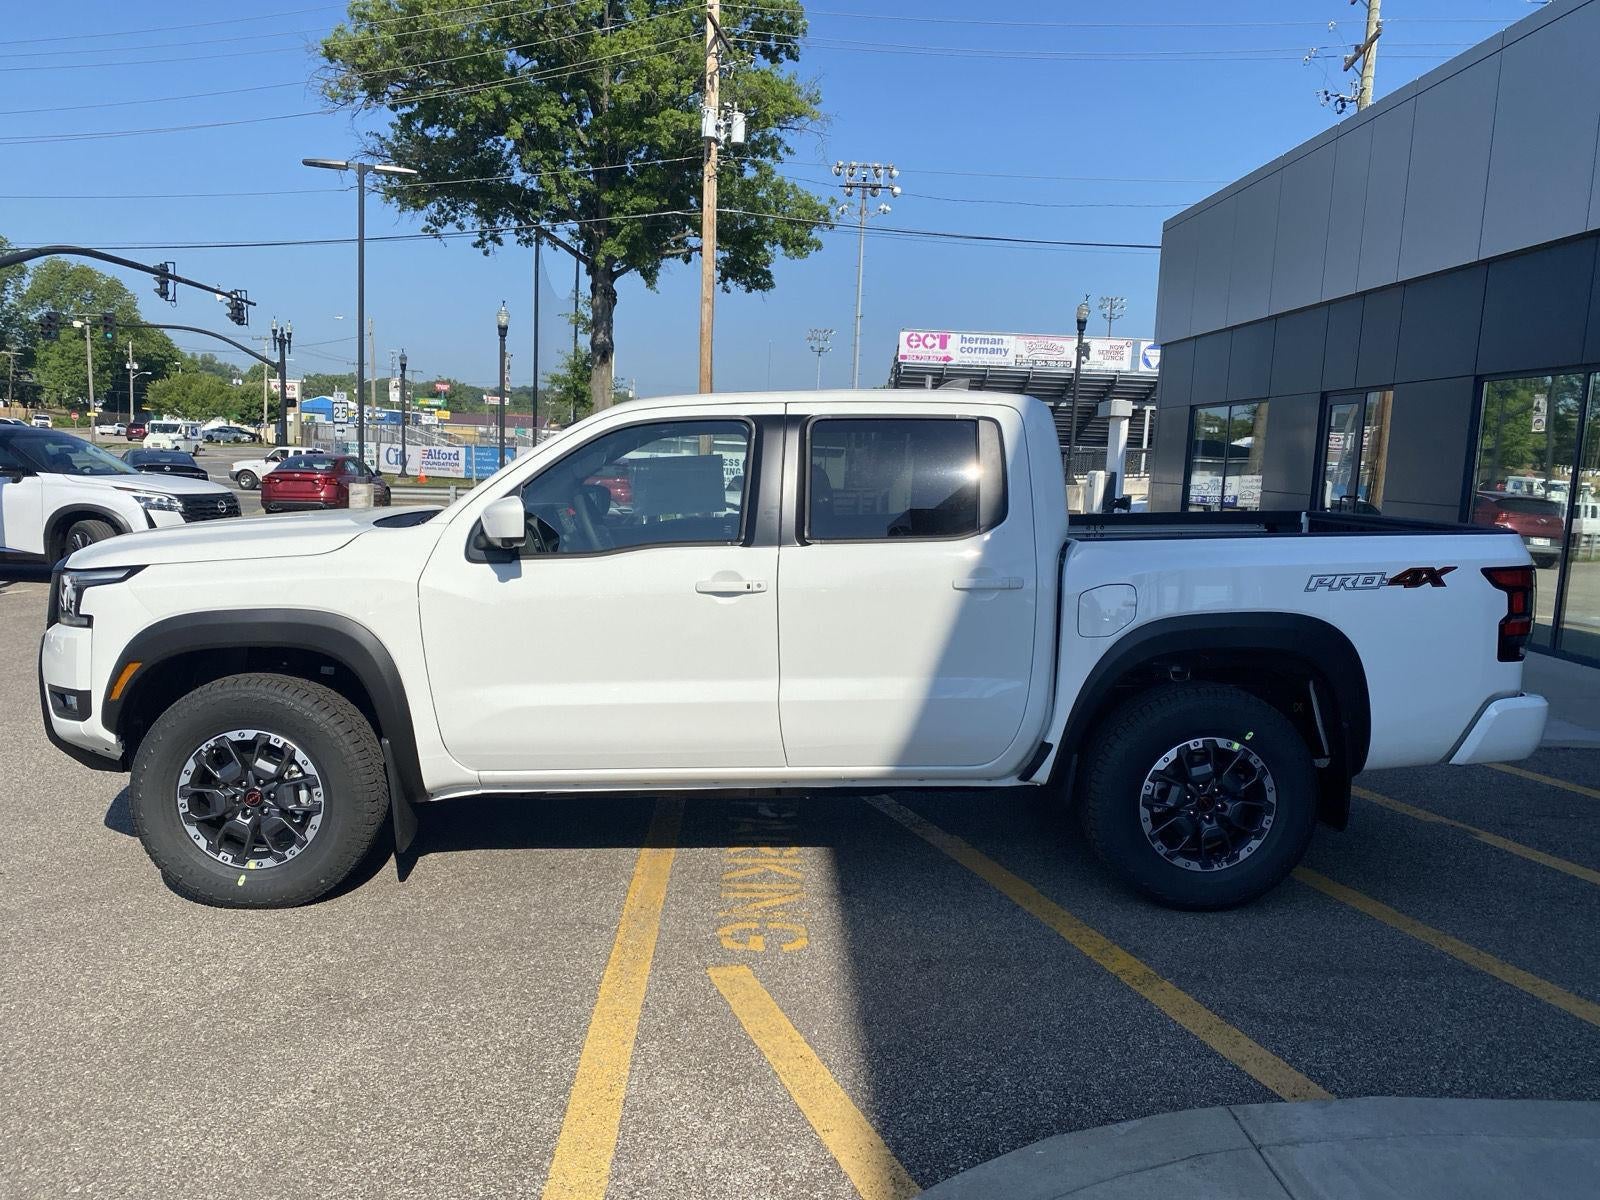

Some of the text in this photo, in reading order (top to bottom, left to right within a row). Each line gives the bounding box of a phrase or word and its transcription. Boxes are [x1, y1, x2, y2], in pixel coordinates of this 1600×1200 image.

[960, 335, 1004, 346] herman
[960, 346, 1010, 357] cormany
[334, 406, 347, 419] 25
[427, 448, 460, 461] Alford
[421, 460, 460, 468] FOUNDATION
